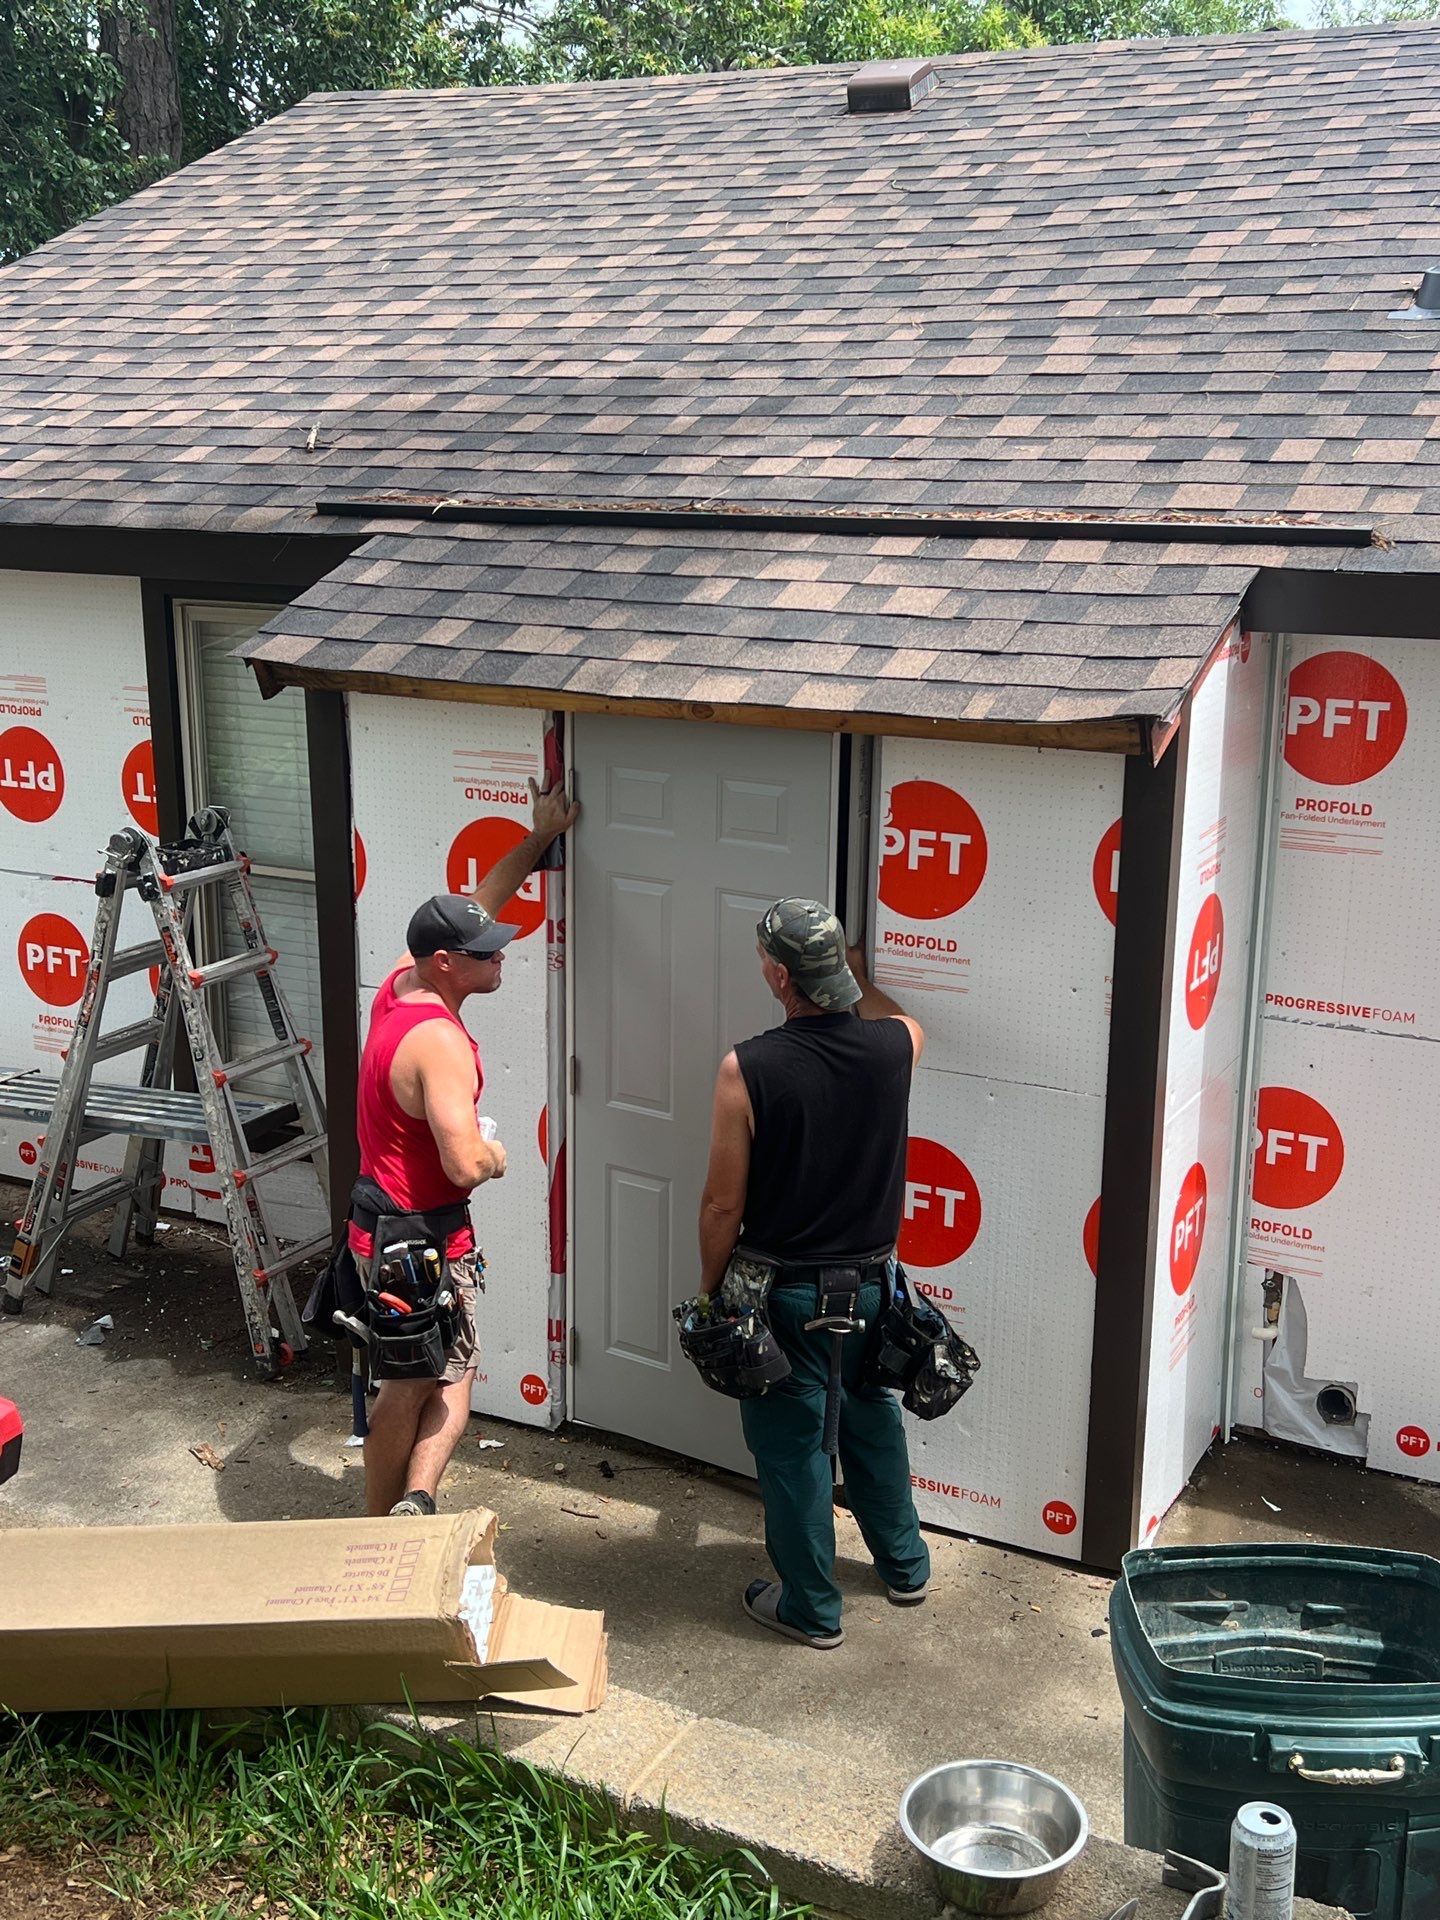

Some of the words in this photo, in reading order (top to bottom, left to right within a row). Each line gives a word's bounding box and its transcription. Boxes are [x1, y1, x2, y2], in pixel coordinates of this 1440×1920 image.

[1287, 696, 1392, 742] PFT
[0, 758, 57, 793] PFT
[453, 776, 501, 788] Underlayment
[465, 787, 528, 805] PROFOLD
[1295, 798, 1373, 816] PROFOLD
[1280, 811, 1326, 823] Fan-Folded
[1327, 816, 1386, 829] Underlayment
[879, 826, 972, 876] PFT
[884, 931, 957, 953] PROFOLD
[26, 942, 82, 978] PFT
[915, 951, 971, 967] Underlayment
[1190, 932, 1220, 993] PFT
[20, 1147, 34, 1158] PFT
[1174, 1196, 1203, 1263] PFT
[1270, 1236, 1326, 1253] Underlayment
[522, 1382, 544, 1396] PFT
[1400, 1433, 1427, 1448] PFT
[1046, 1509, 1073, 1526] PFT
[346, 1543, 387, 1552] Channels
[344, 1556, 385, 1566] Channels
[294, 1585, 332, 1594] Channel
[266, 1598, 304, 1606] Channel
